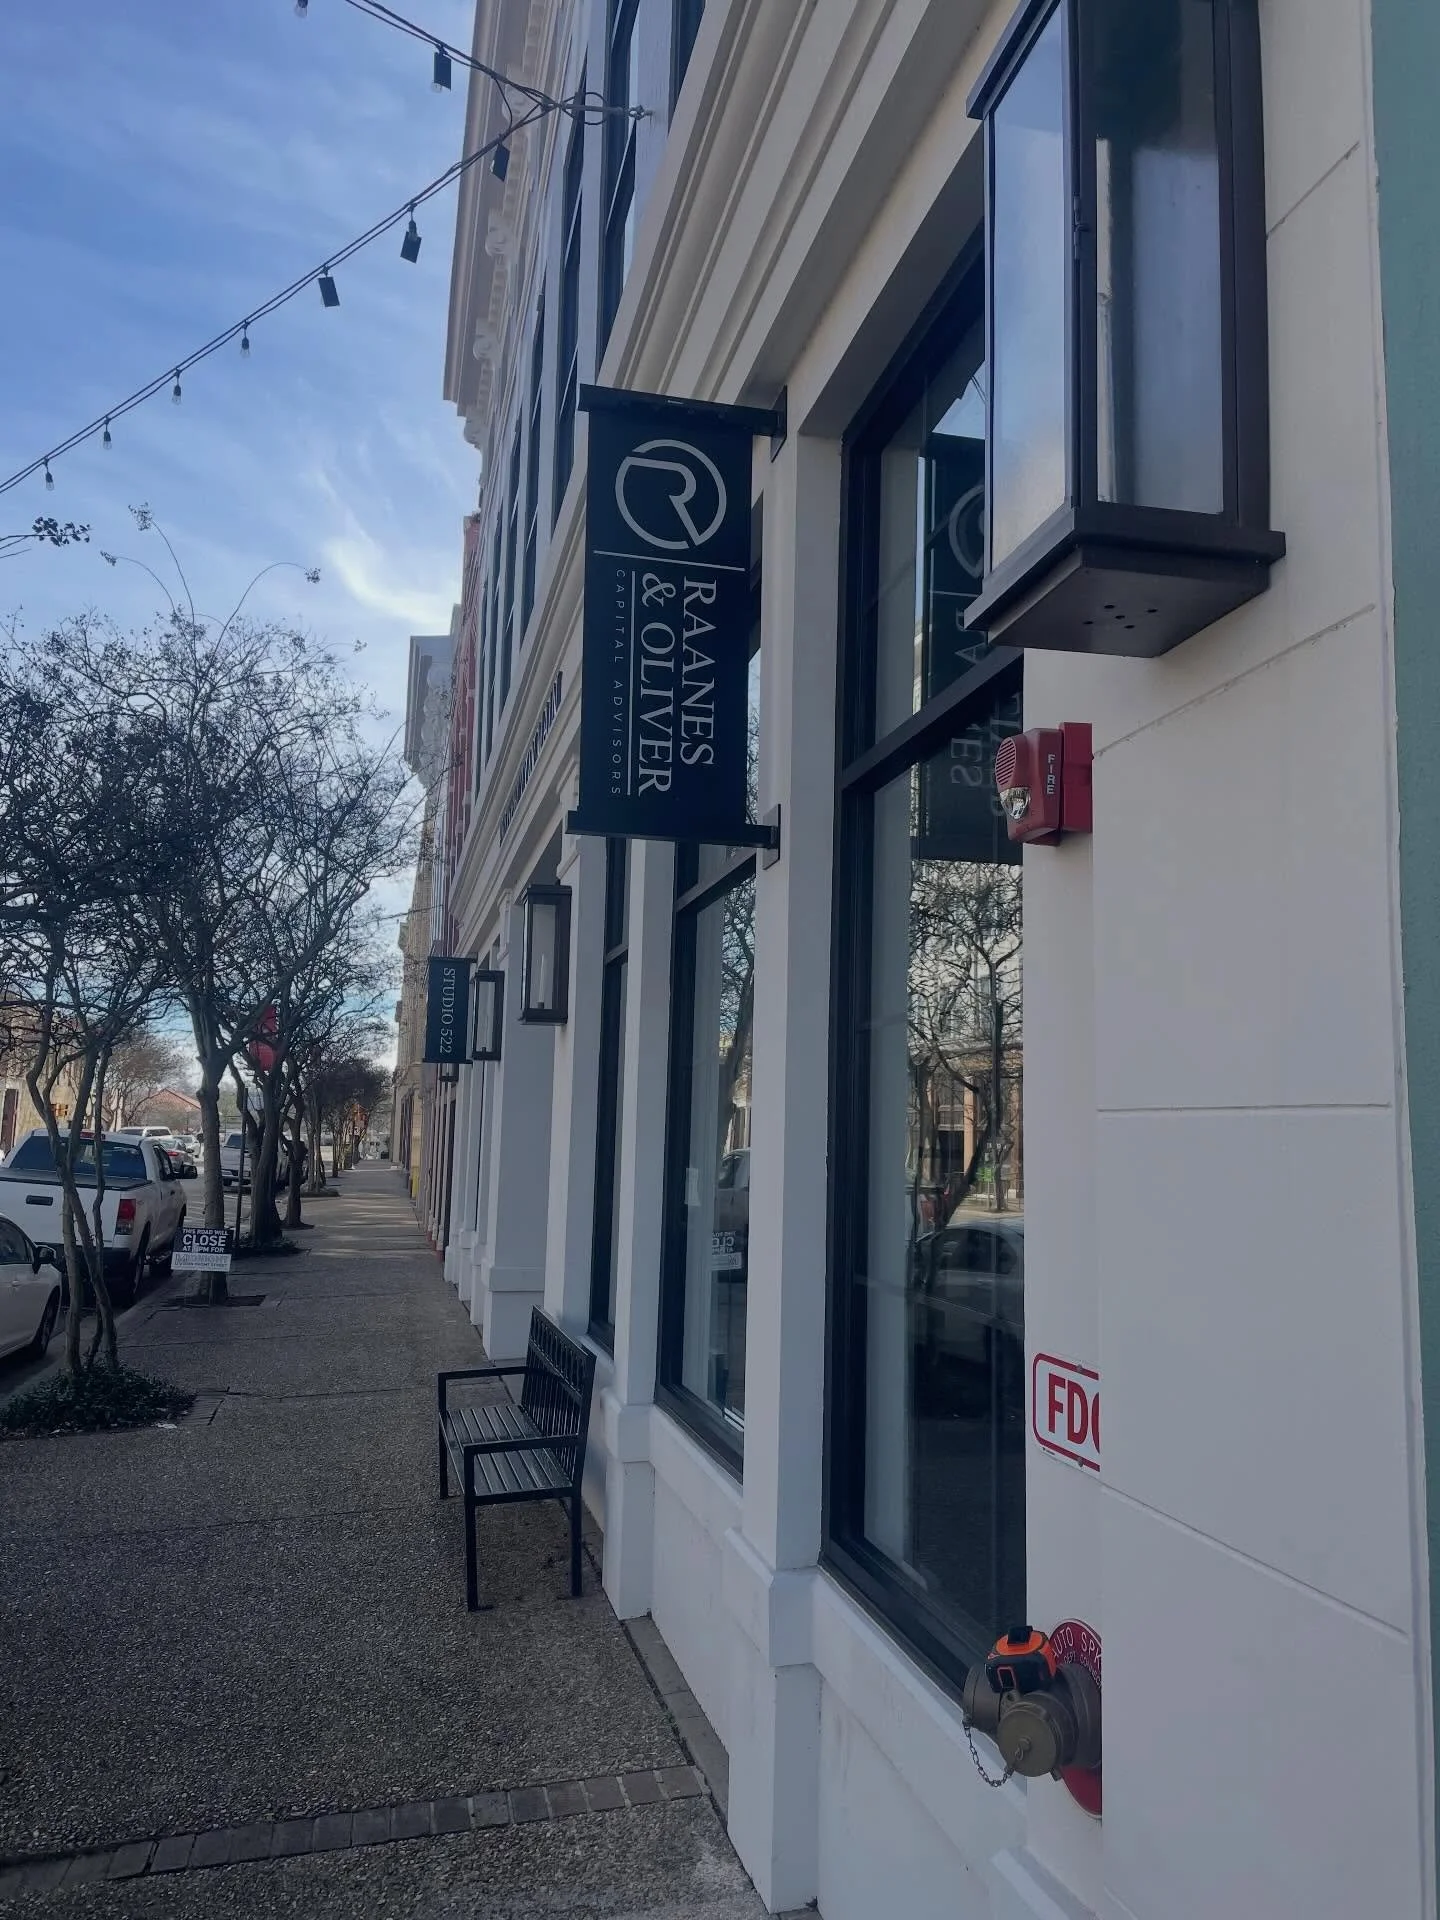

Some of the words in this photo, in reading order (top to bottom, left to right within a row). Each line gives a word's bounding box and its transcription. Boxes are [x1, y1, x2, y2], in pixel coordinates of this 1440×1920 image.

[613, 568, 626, 664] CAPITAL
[641, 572, 676, 608] &
[679, 576, 717, 766] RAANES
[611, 680, 622, 795] ADVISORS
[638, 622, 675, 797] OLIVER
[1047, 753, 1056, 795] FIRE
[441, 967, 456, 1025] STUDIO
[440, 1028, 453, 1054] 522
[182, 1234, 227, 1247] CLOSE
